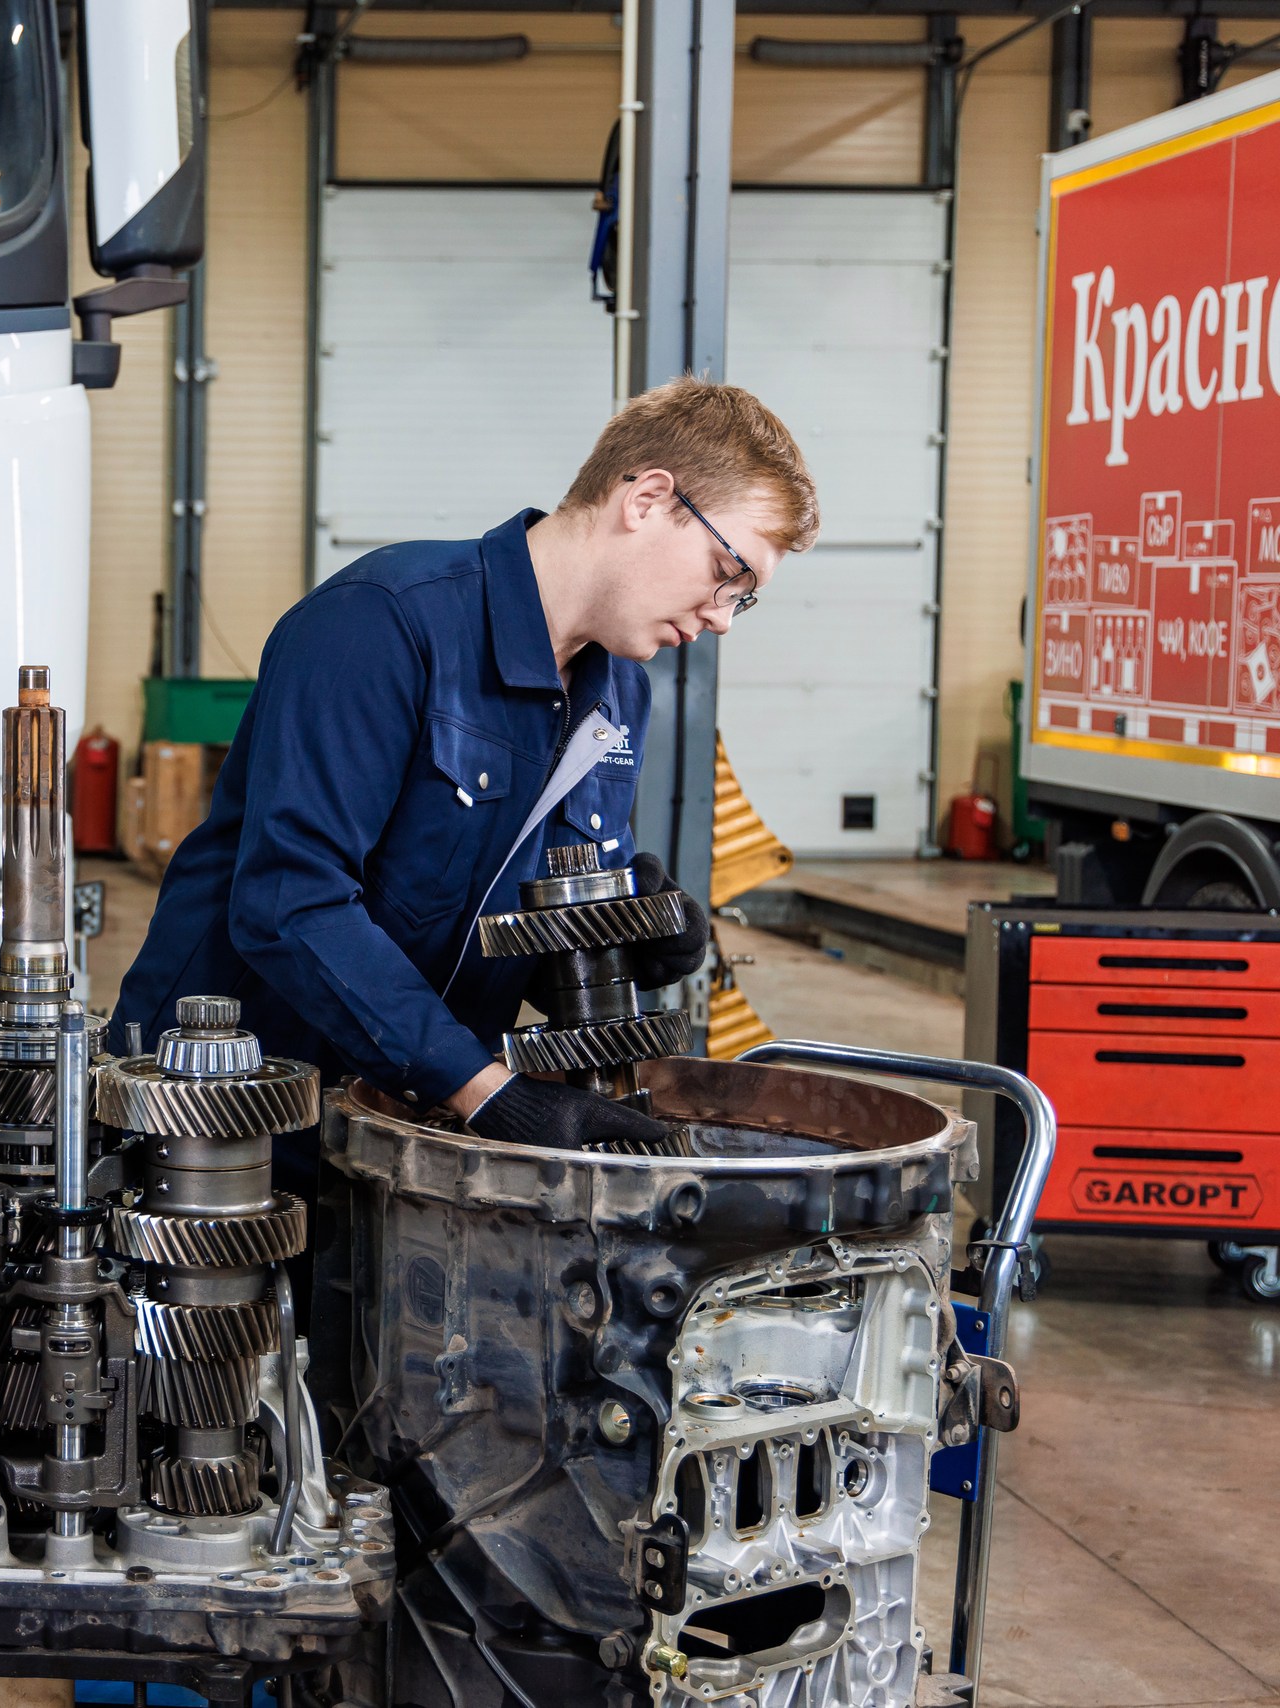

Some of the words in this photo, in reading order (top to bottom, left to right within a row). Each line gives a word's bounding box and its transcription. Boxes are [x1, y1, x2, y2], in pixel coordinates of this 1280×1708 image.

[1146, 514, 1174, 547] СЫР
[1098, 562, 1130, 595] ПИВО
[1188, 618, 1228, 657] КОФЕ
[1045, 639, 1083, 679] ВИНО
[599, 756, 634, 766] AFT-GEAR
[1086, 1180, 1248, 1208] GAROPT
